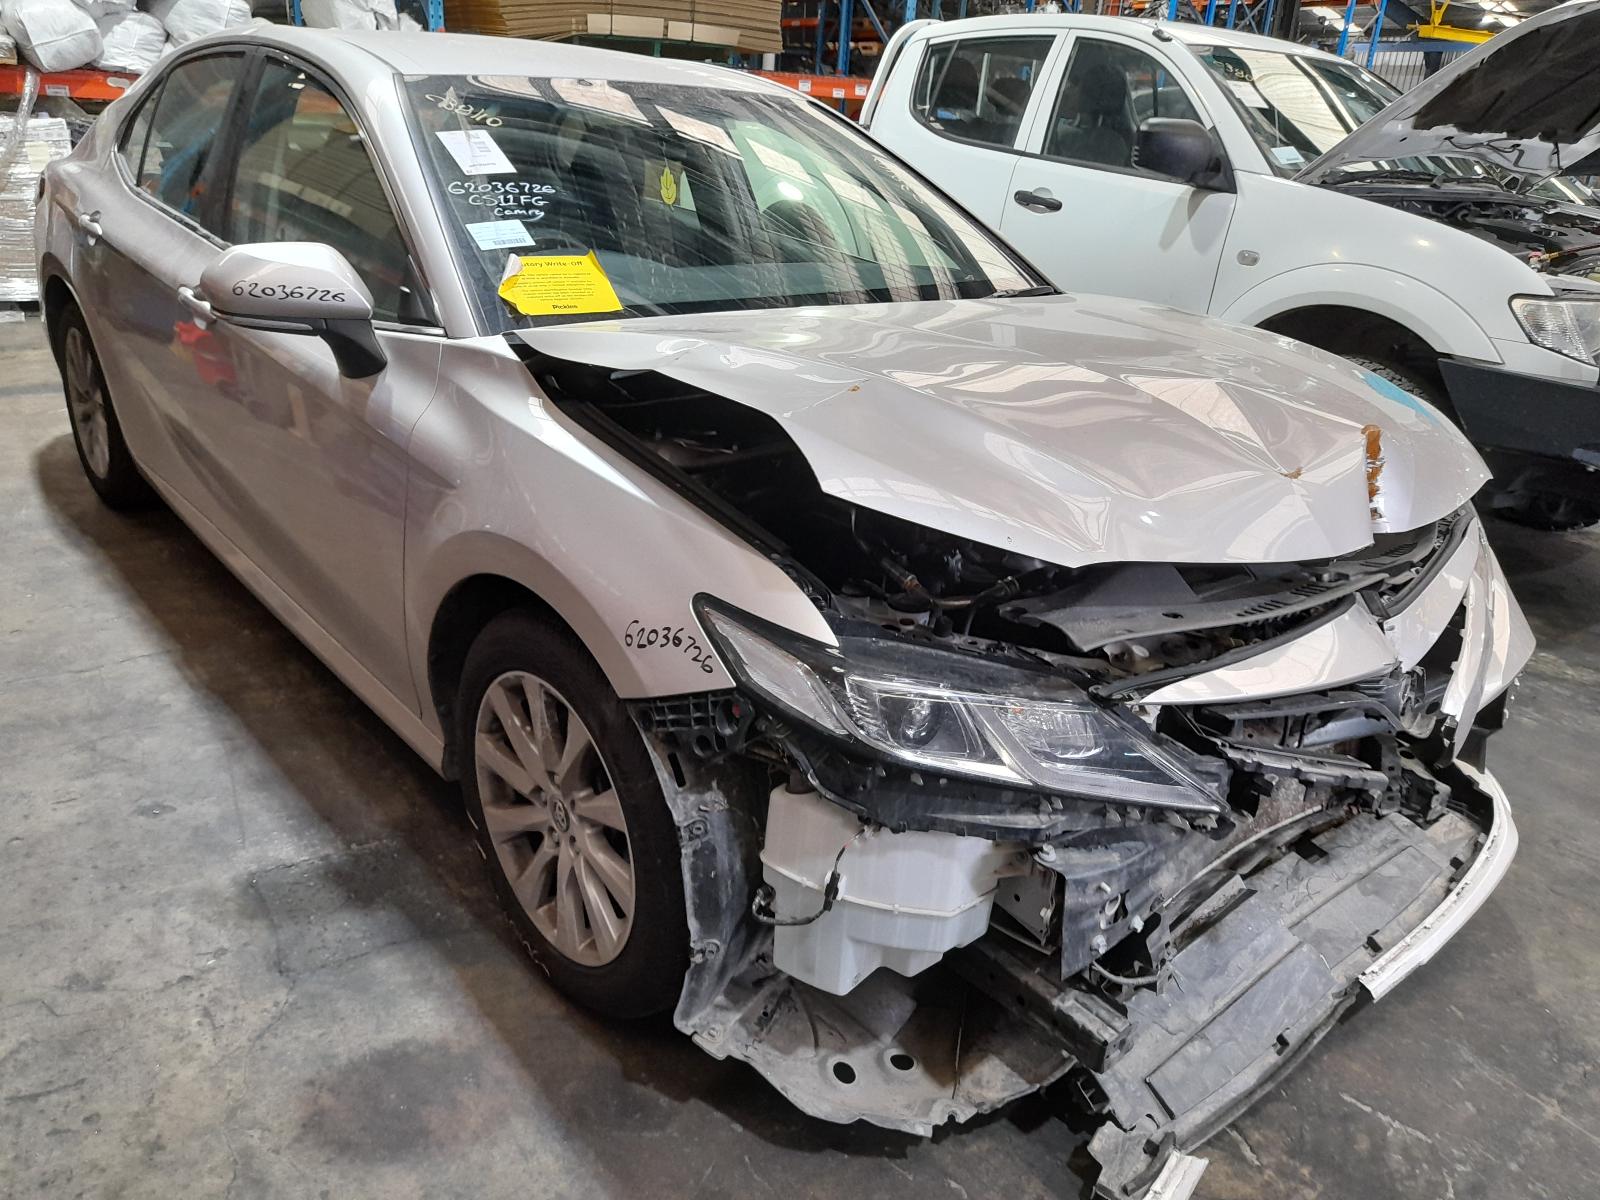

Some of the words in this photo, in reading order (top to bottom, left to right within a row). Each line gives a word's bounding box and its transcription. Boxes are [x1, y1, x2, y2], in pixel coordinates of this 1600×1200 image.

[448, 181, 556, 194] 62036726
[232, 280, 345, 302] 62036726
[624, 620, 714, 674] 62036726
